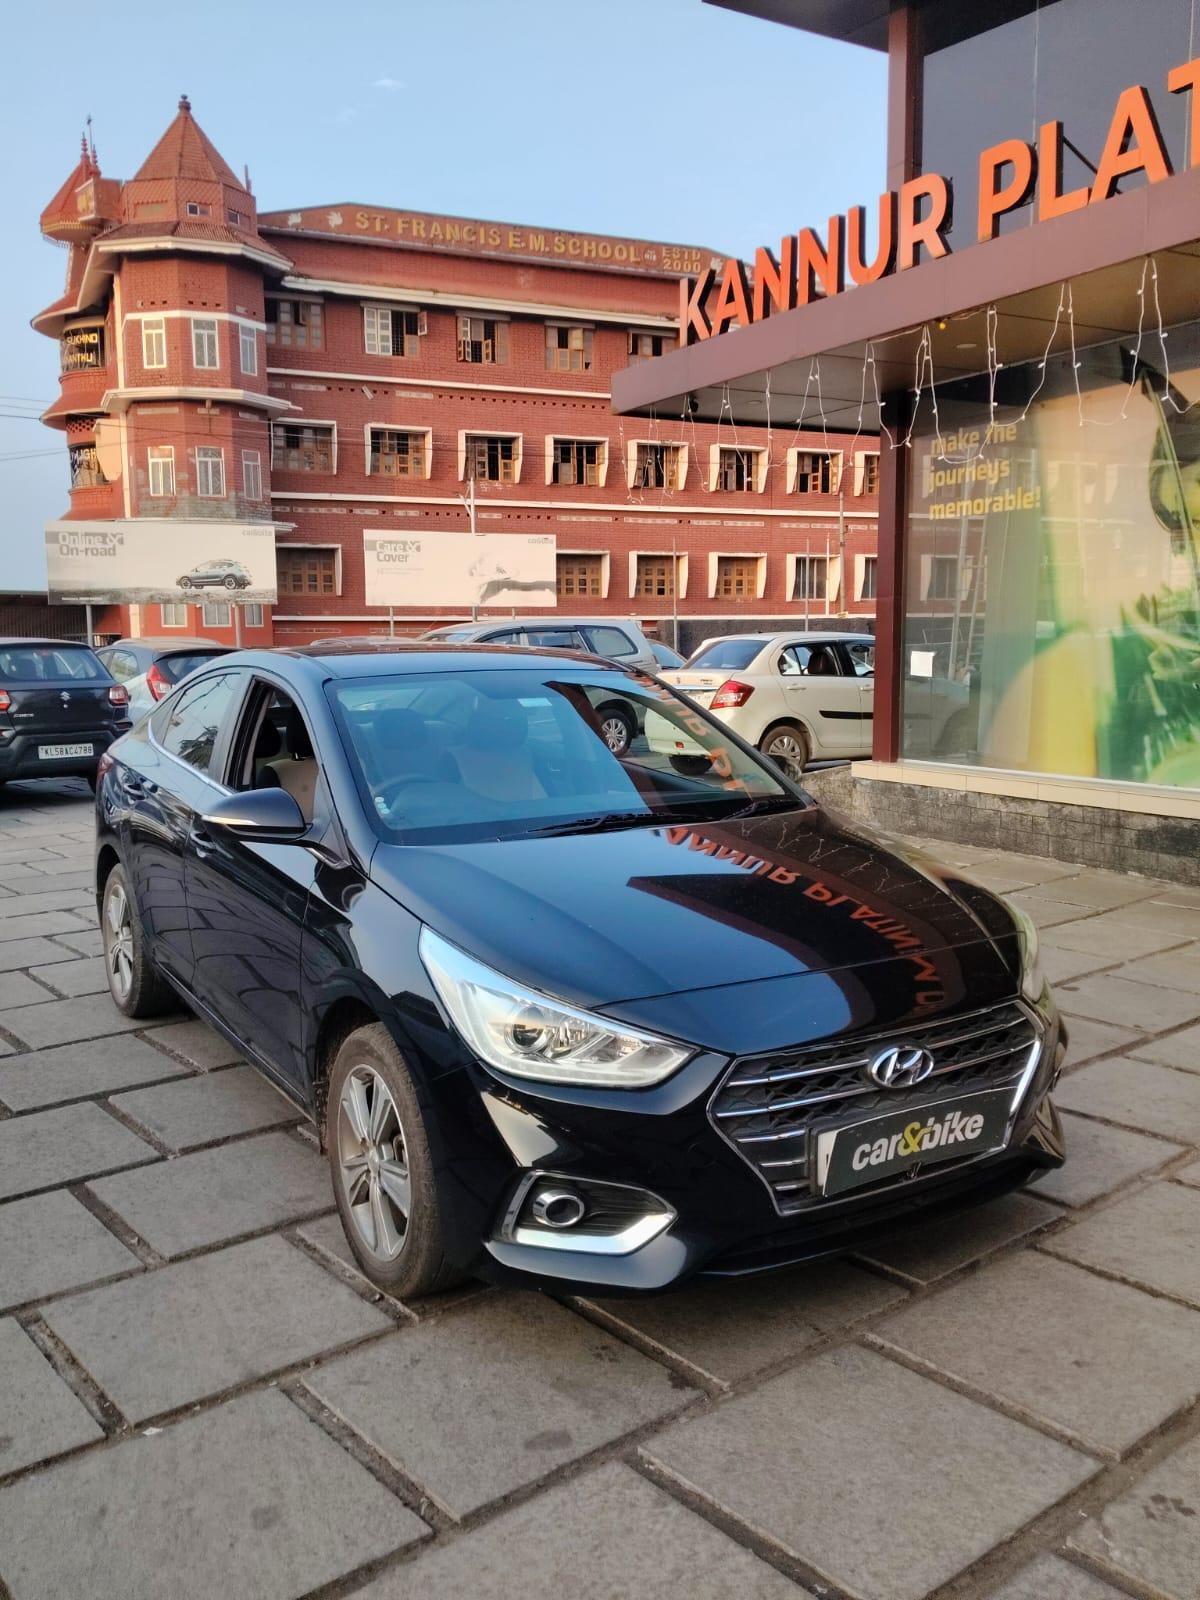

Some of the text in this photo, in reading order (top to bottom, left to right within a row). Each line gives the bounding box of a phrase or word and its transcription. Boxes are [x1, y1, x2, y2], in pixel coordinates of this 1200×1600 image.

[355, 211, 389, 233] ST.
[397, 218, 501, 245] FRANCIS
[662, 246, 701, 261] ESTD
[680, 173, 952, 348] KANNUR
[663, 259, 701, 273] 2000
[931, 428, 979, 454] make
[929, 458, 1010, 493] journeys
[929, 486, 1041, 520] memorable!
[58, 531, 103, 546] Online
[376, 540, 404, 552] Care
[59, 543, 117, 557] On-road
[376, 551, 410, 563] Cover
[852, 1110, 985, 1171] car&bike
